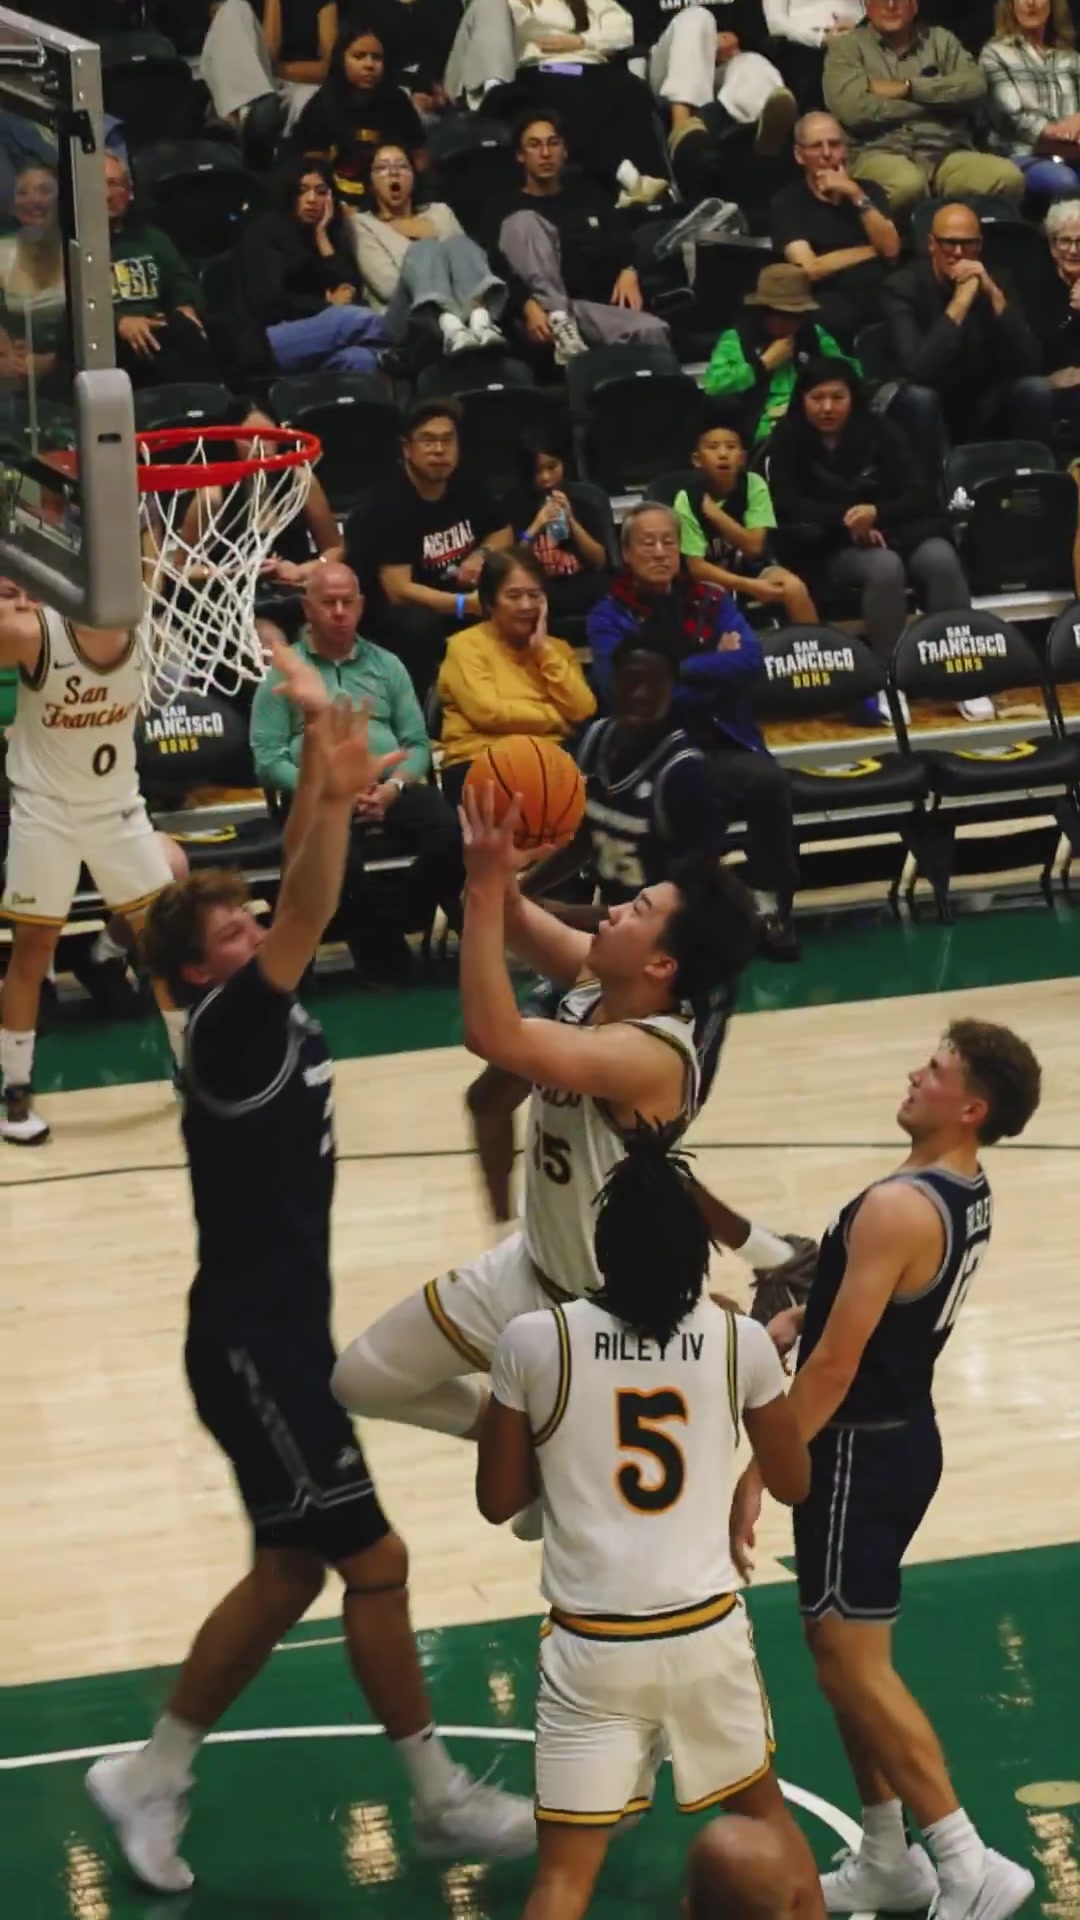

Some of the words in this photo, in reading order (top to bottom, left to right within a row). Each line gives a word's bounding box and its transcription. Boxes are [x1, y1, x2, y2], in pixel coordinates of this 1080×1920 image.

[793, 640, 818, 652] SAN
[945, 625, 970, 638] SAN
[764, 648, 855, 680] FRANCISCO
[918, 633, 1007, 665] FRANCISCO
[64, 676, 108, 704] San
[42, 702, 137, 729] Francis
[144, 712, 225, 743] ANCISCO
[92, 743, 117, 776] 0
[594, 1332, 668, 1362] RILEY
[681, 1333, 704, 1362] IV
[613, 1386, 690, 1516] 5
